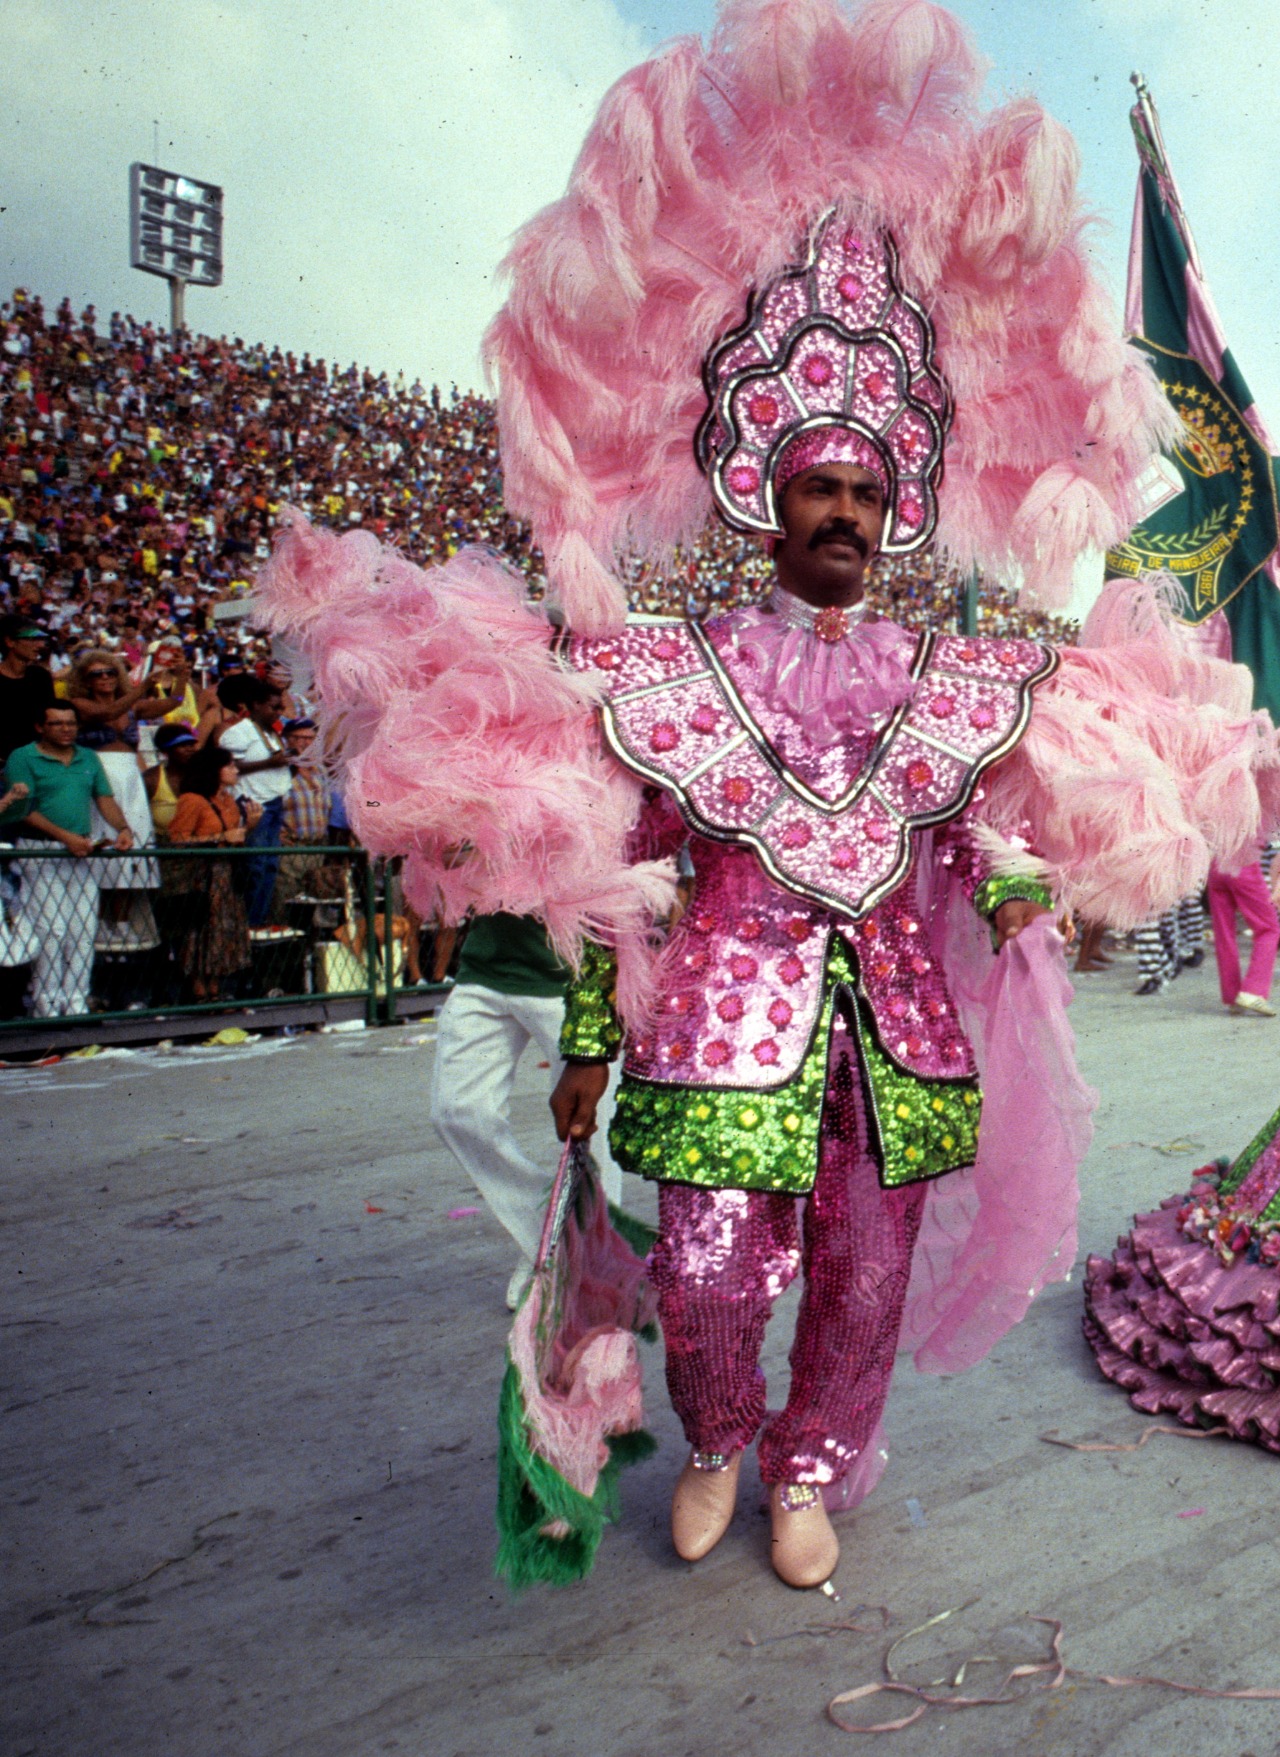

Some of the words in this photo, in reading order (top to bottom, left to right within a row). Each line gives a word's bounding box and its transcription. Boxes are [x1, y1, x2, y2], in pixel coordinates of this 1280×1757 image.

[1147, 556, 1164, 569] DE
[1169, 537, 1229, 571] MANGUEIRA
[1200, 570, 1213, 597] 1987
